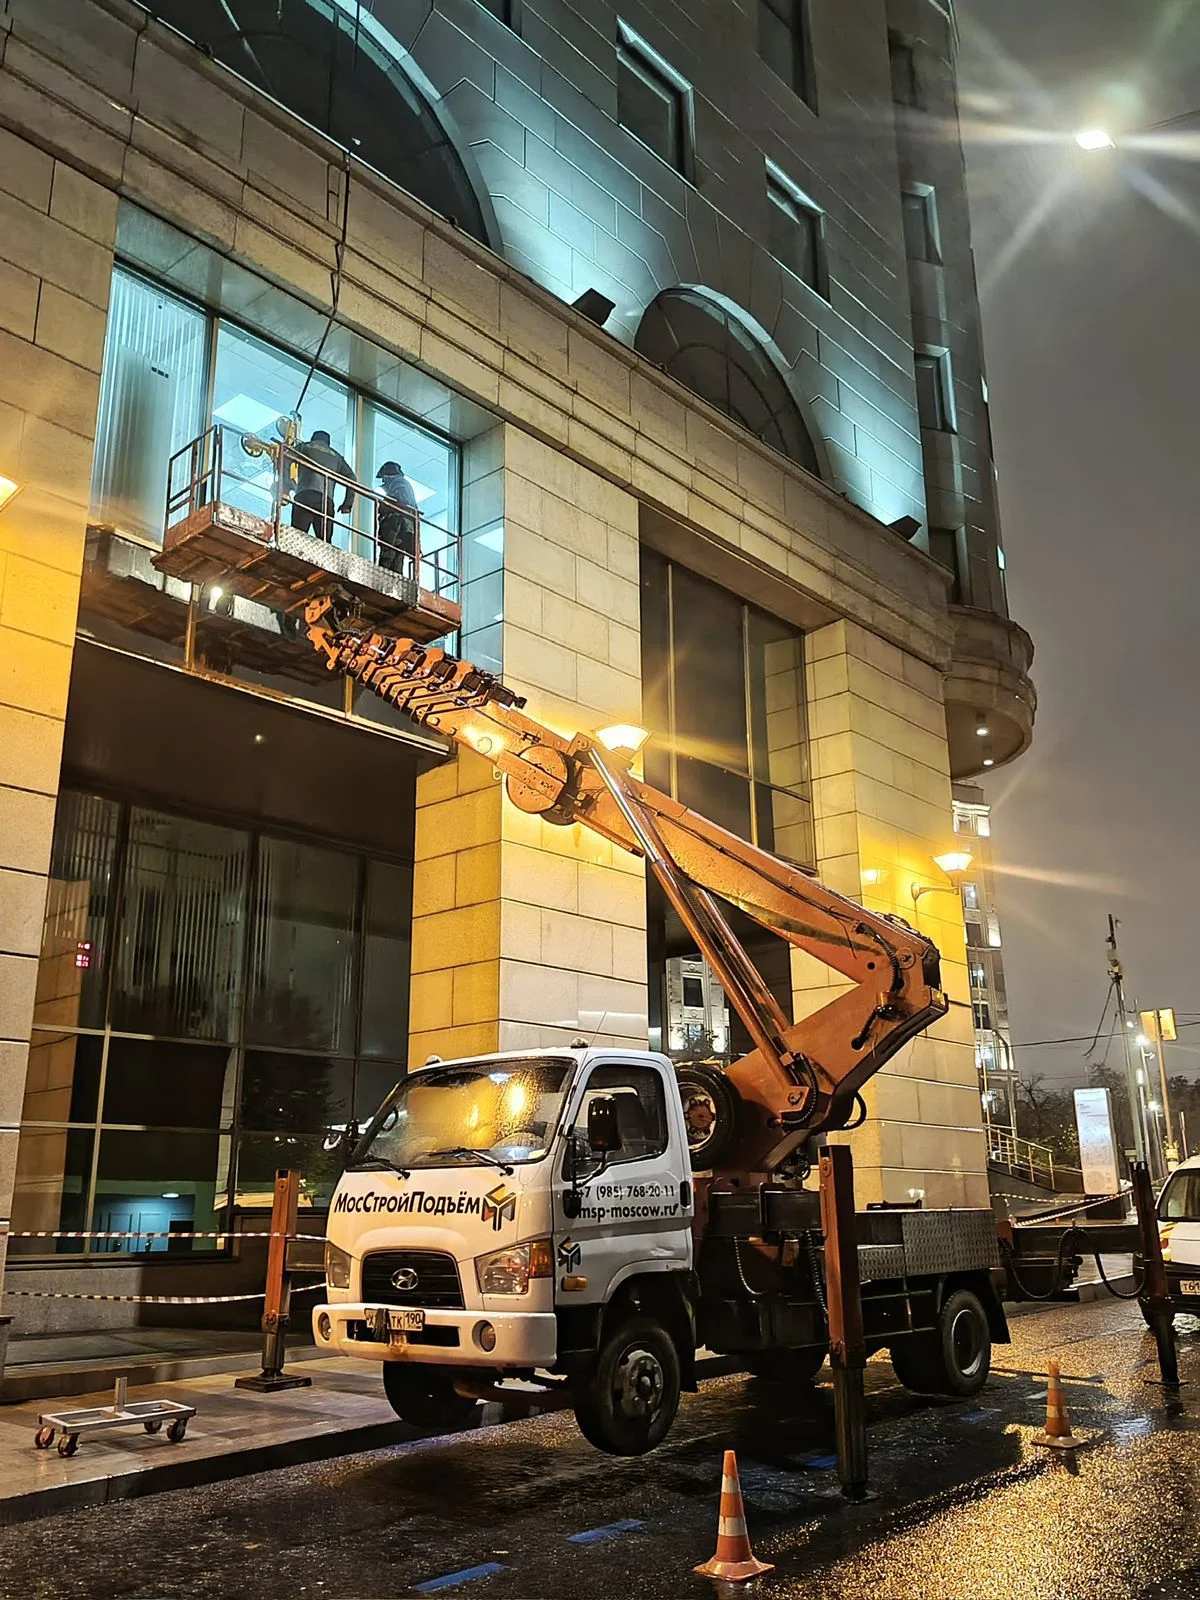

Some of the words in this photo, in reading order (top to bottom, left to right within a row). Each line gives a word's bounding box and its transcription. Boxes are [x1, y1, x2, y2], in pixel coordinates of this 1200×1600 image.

[596, 1185, 623, 1201] (985)
[626, 1184, 675, 1198] 768-20-11
[579, 1204, 677, 1223] msp-moscow.ru
[404, 1312, 422, 1325] 190
